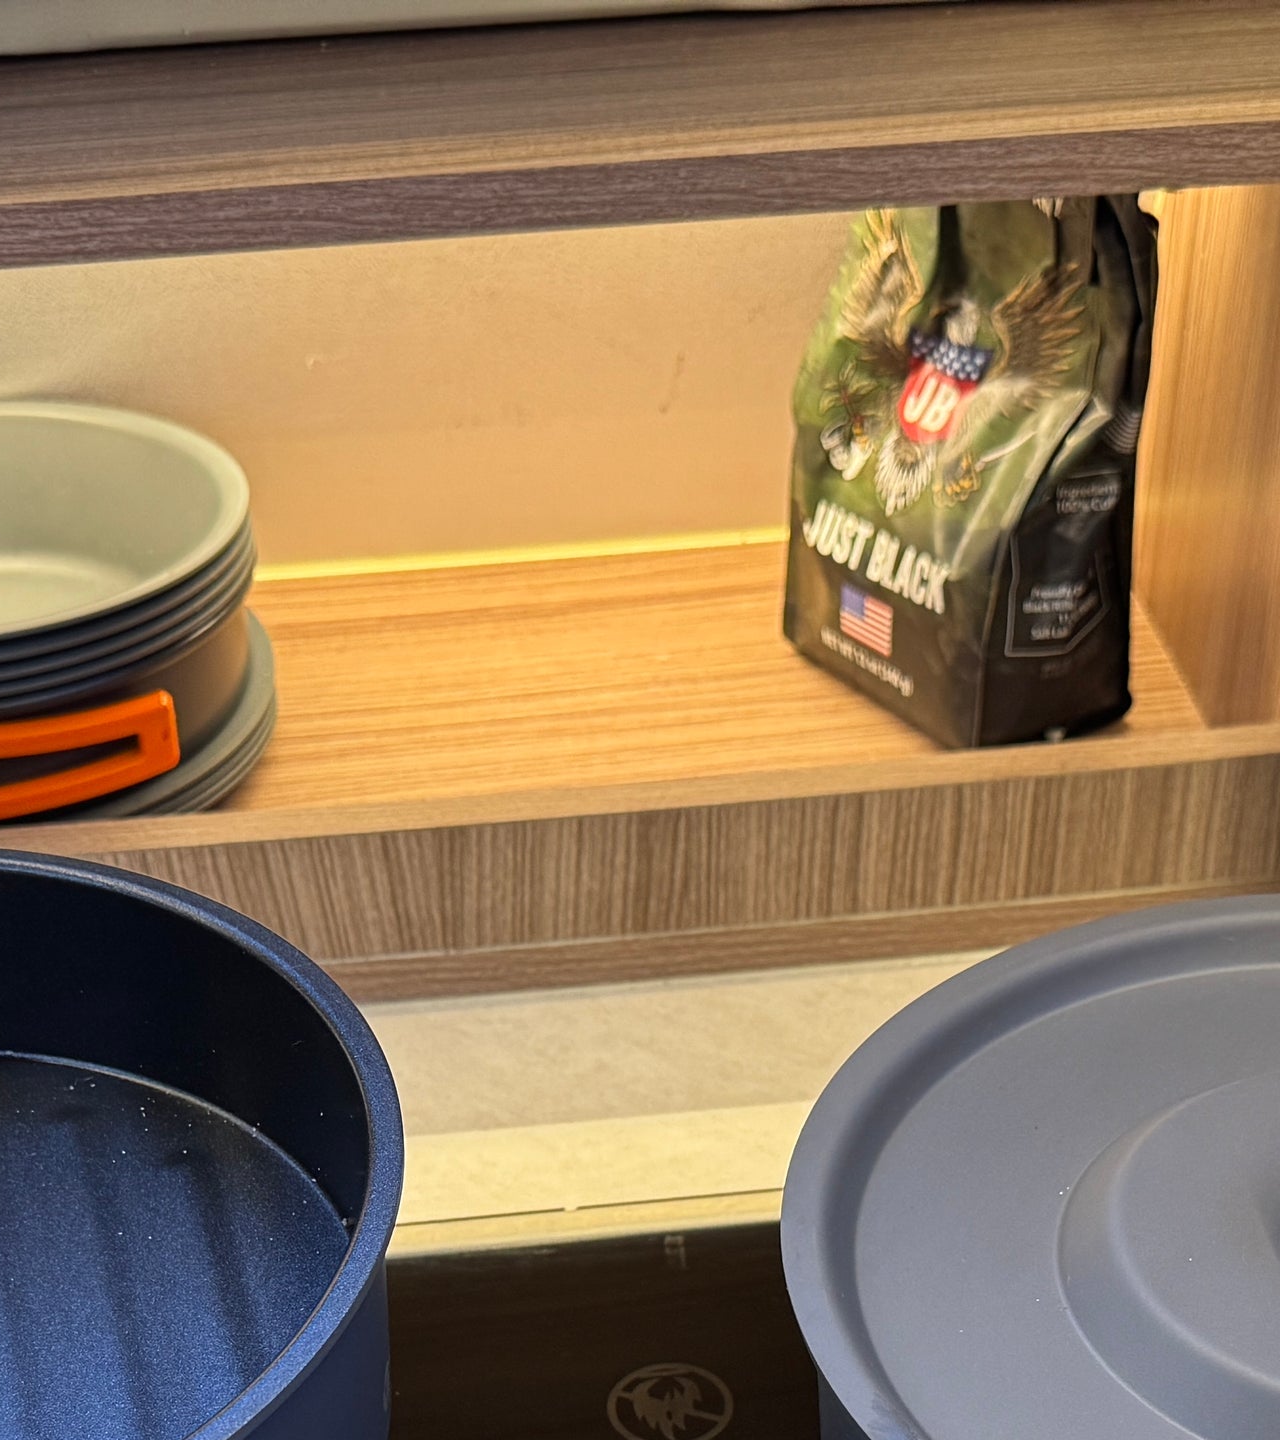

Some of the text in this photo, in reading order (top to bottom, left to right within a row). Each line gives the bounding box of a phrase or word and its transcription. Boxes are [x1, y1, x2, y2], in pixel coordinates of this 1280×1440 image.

[903, 376, 960, 432] JB
[803, 500, 949, 615] JUST BLACK
